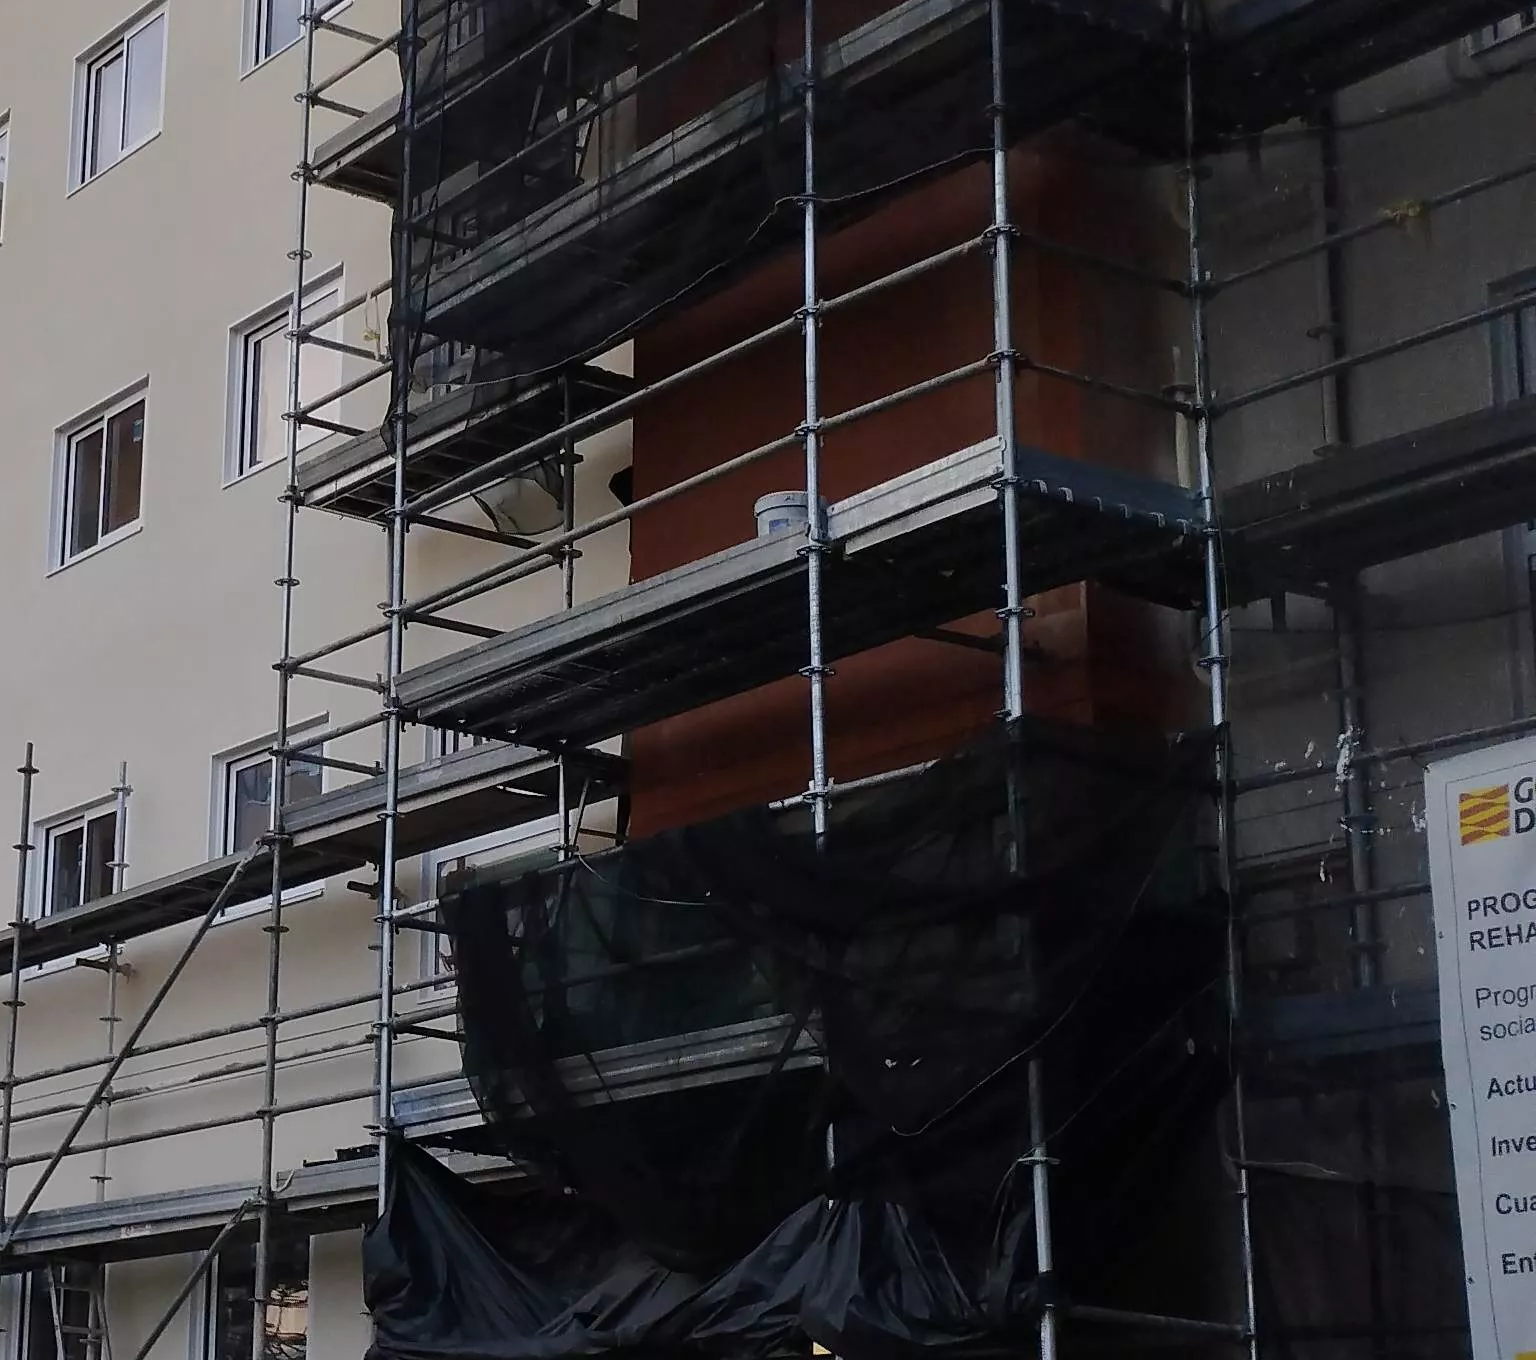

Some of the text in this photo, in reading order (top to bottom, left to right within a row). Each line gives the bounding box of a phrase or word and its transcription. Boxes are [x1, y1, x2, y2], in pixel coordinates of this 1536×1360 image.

[1514, 776, 1536, 803] G
[1468, 889, 1536, 921] PROG
[1470, 922, 1536, 951] REHA
[1476, 984, 1536, 1009] Progr
[1487, 1074, 1536, 1099] Actu
[1492, 1135, 1536, 1157] Inve
